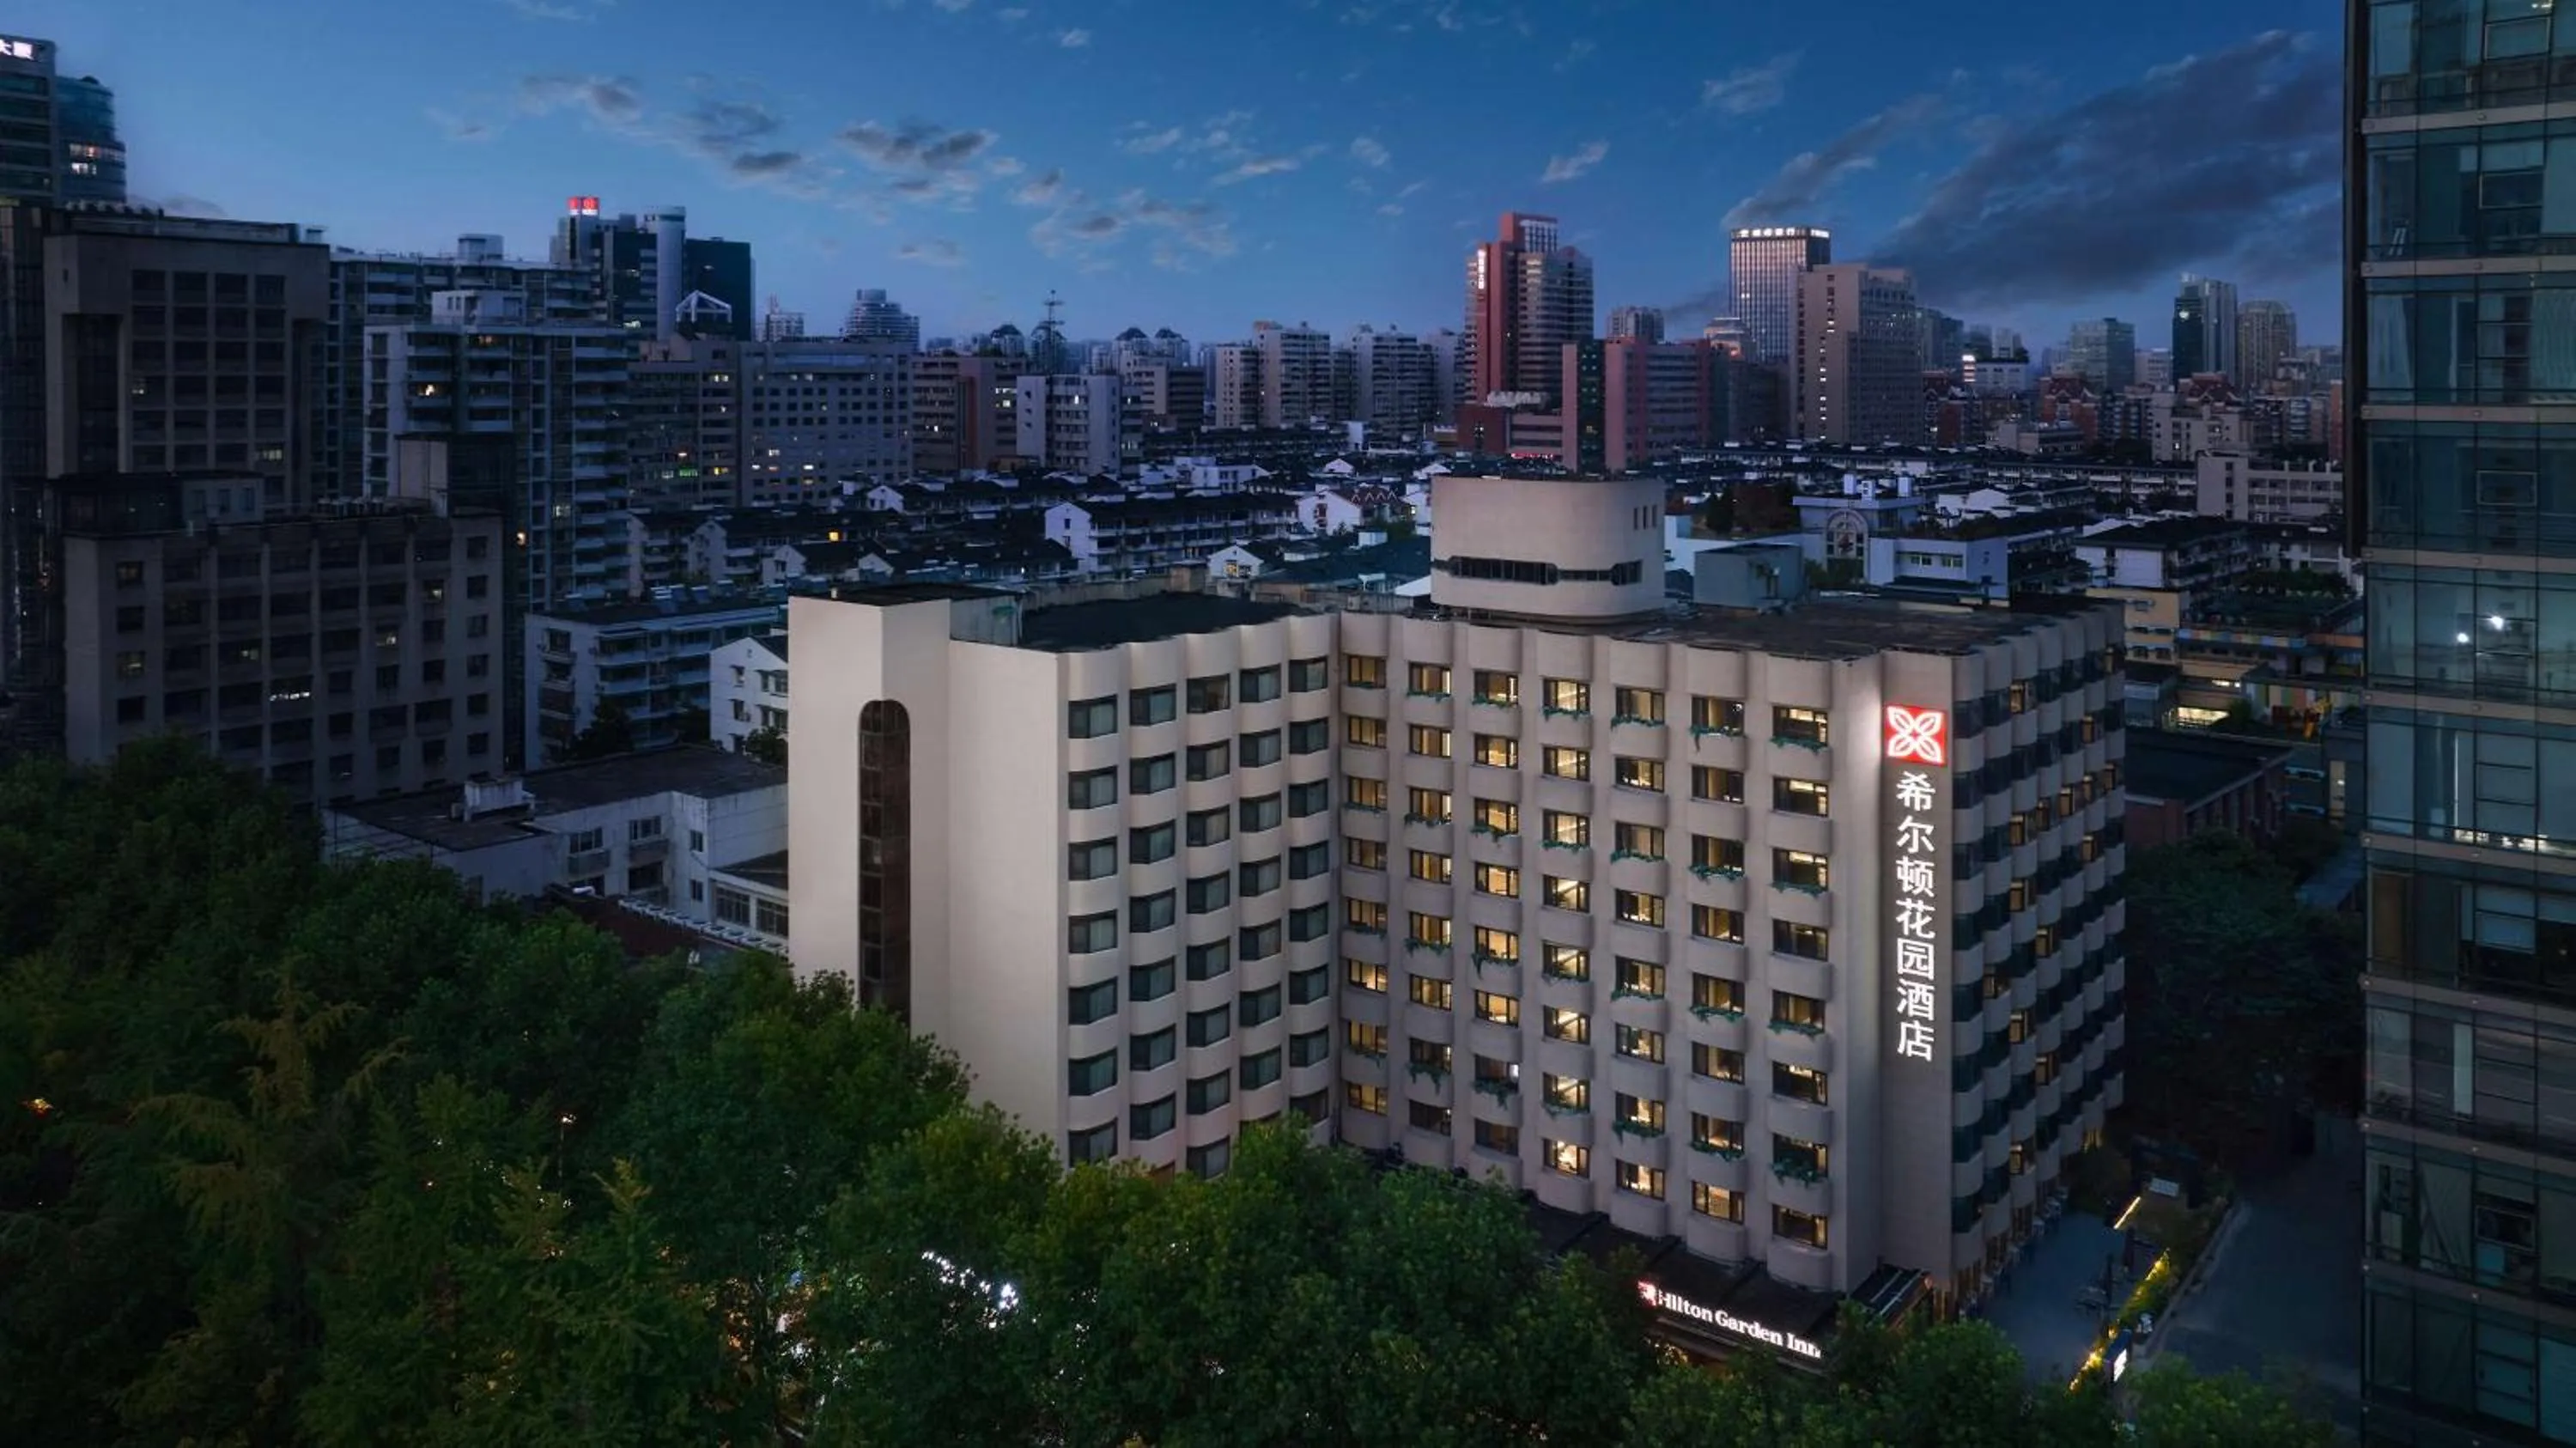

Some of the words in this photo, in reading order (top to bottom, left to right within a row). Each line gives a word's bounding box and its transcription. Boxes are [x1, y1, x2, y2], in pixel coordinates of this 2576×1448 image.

[1895, 770, 1936, 1062] 希尔顿花园酒店
[1658, 1288, 1714, 1323] Hilton
[1715, 1310, 1783, 1347] Garden
[1787, 1331, 1821, 1359] Inn
